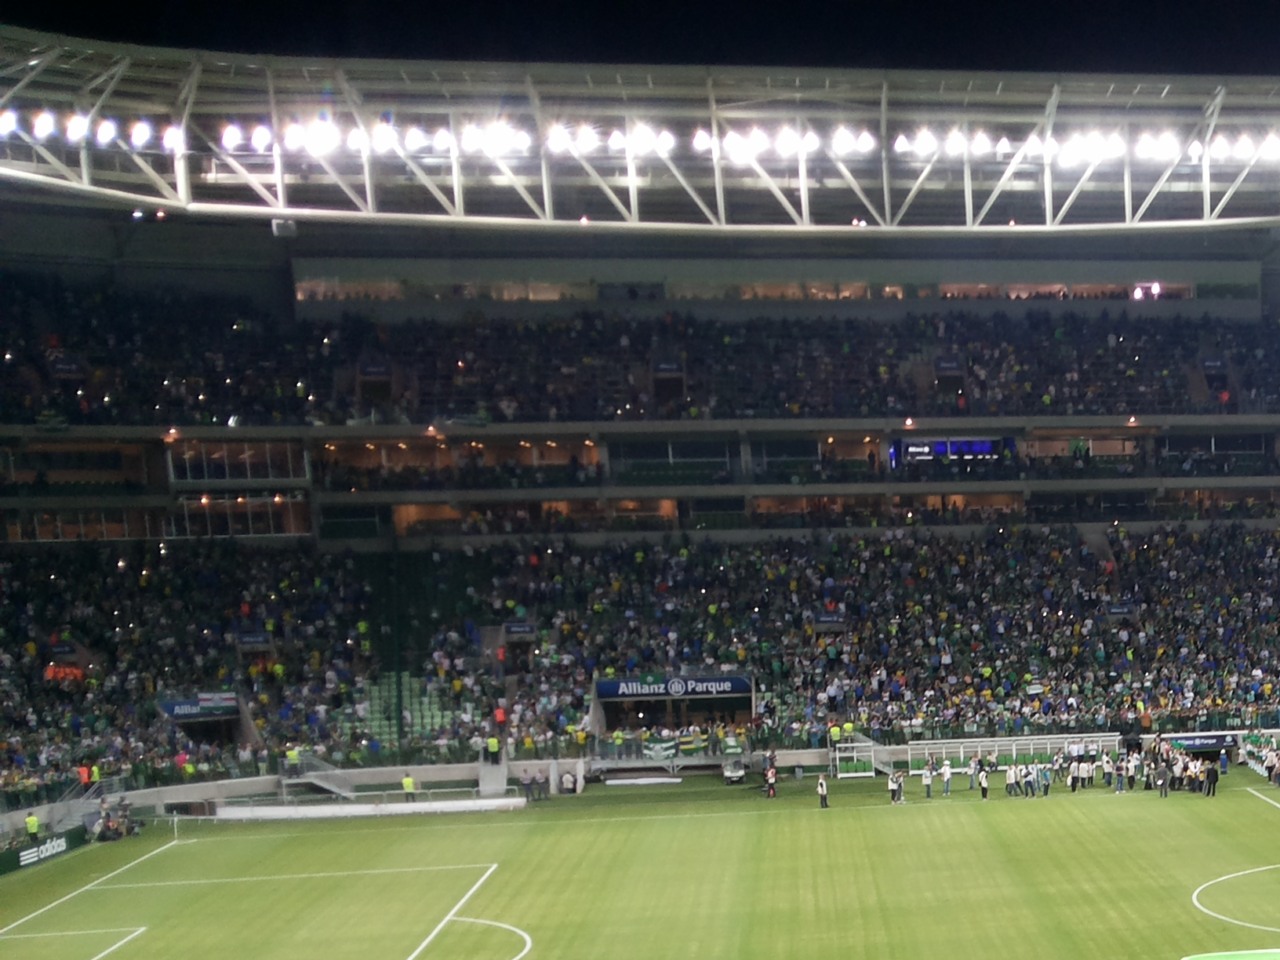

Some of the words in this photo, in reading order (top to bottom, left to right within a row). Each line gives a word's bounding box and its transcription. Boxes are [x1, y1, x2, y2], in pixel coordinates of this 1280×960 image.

[618, 681, 666, 695] Allianz
[687, 680, 732, 694] Parque
[38, 837, 67, 859] adidas
